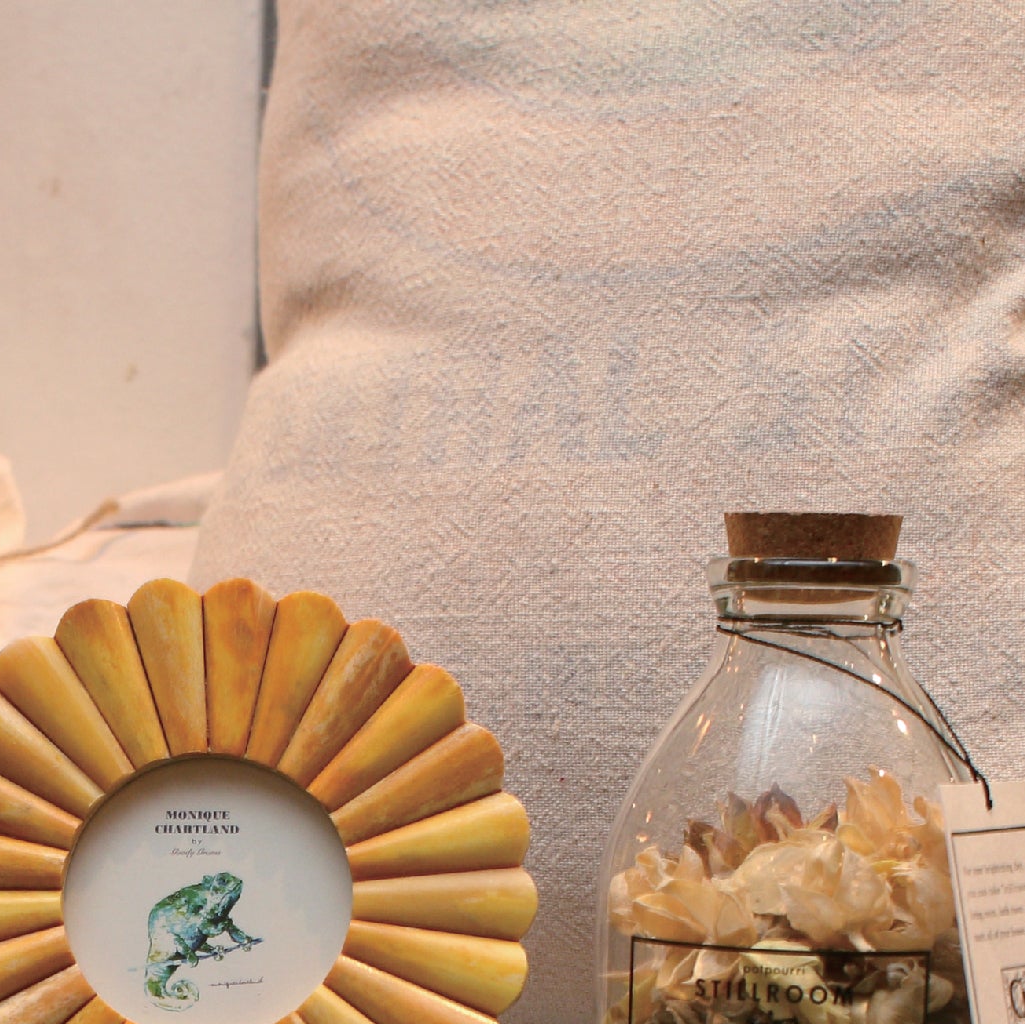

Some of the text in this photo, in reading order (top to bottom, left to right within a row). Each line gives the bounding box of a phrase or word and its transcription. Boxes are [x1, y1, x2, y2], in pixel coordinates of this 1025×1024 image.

[165, 810, 231, 822] MONIQUE
[154, 824, 240, 835] CHARTLAND
[695, 978, 854, 1007] STILLROOM
